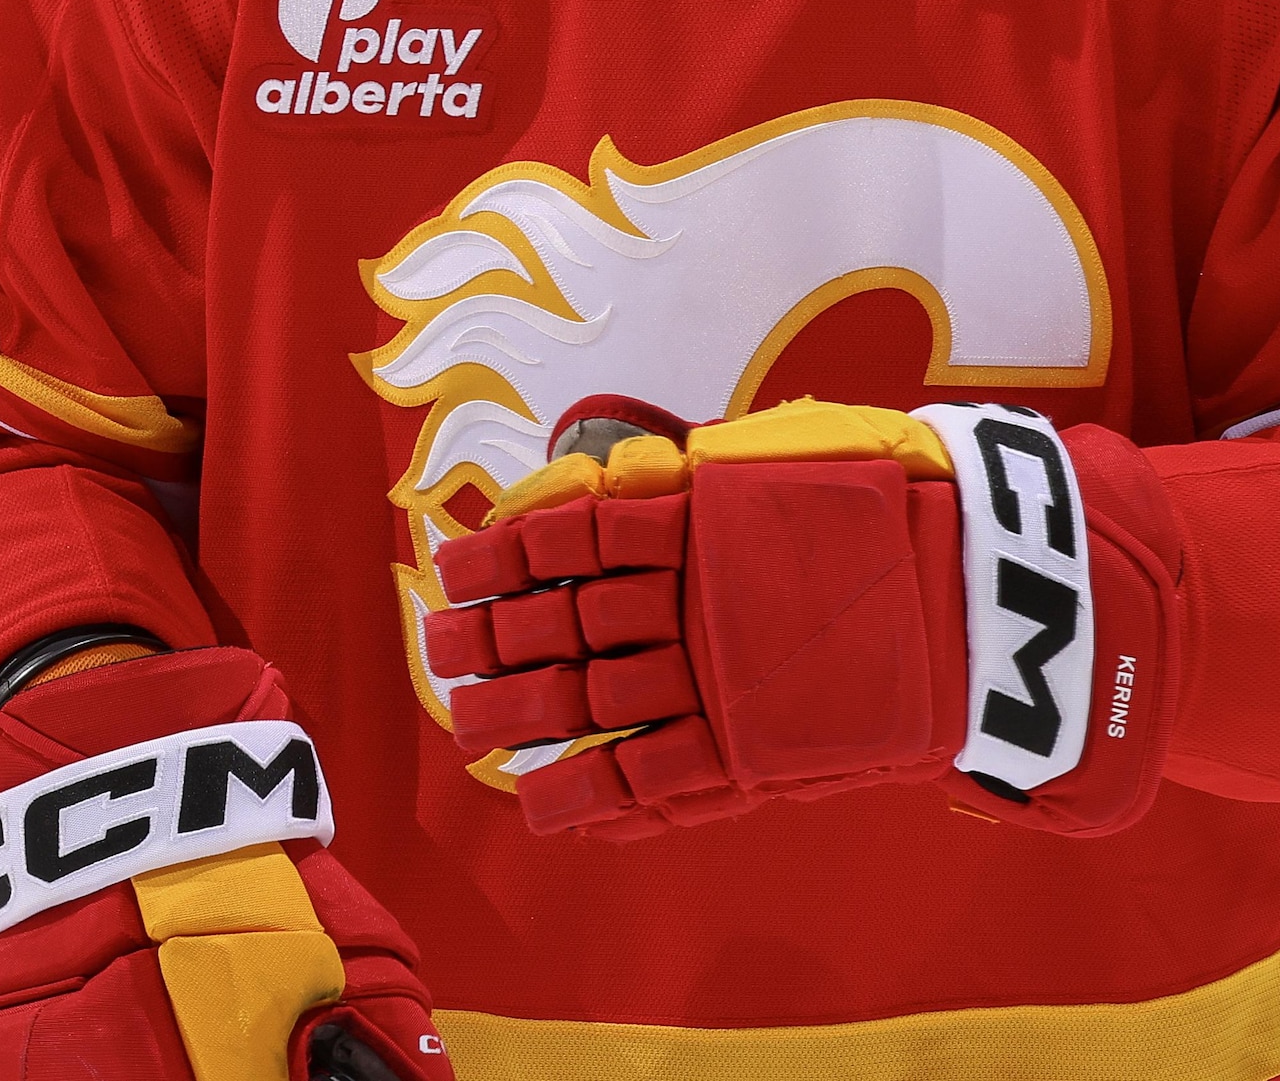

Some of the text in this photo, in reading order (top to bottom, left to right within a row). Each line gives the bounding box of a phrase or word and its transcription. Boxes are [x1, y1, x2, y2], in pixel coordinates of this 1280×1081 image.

[337, 18, 483, 76] play
[256, 71, 483, 118] alberta
[942, 401, 1078, 758] CM
[1107, 653, 1137, 739] KERINS
[419, 1034, 446, 1056] C
